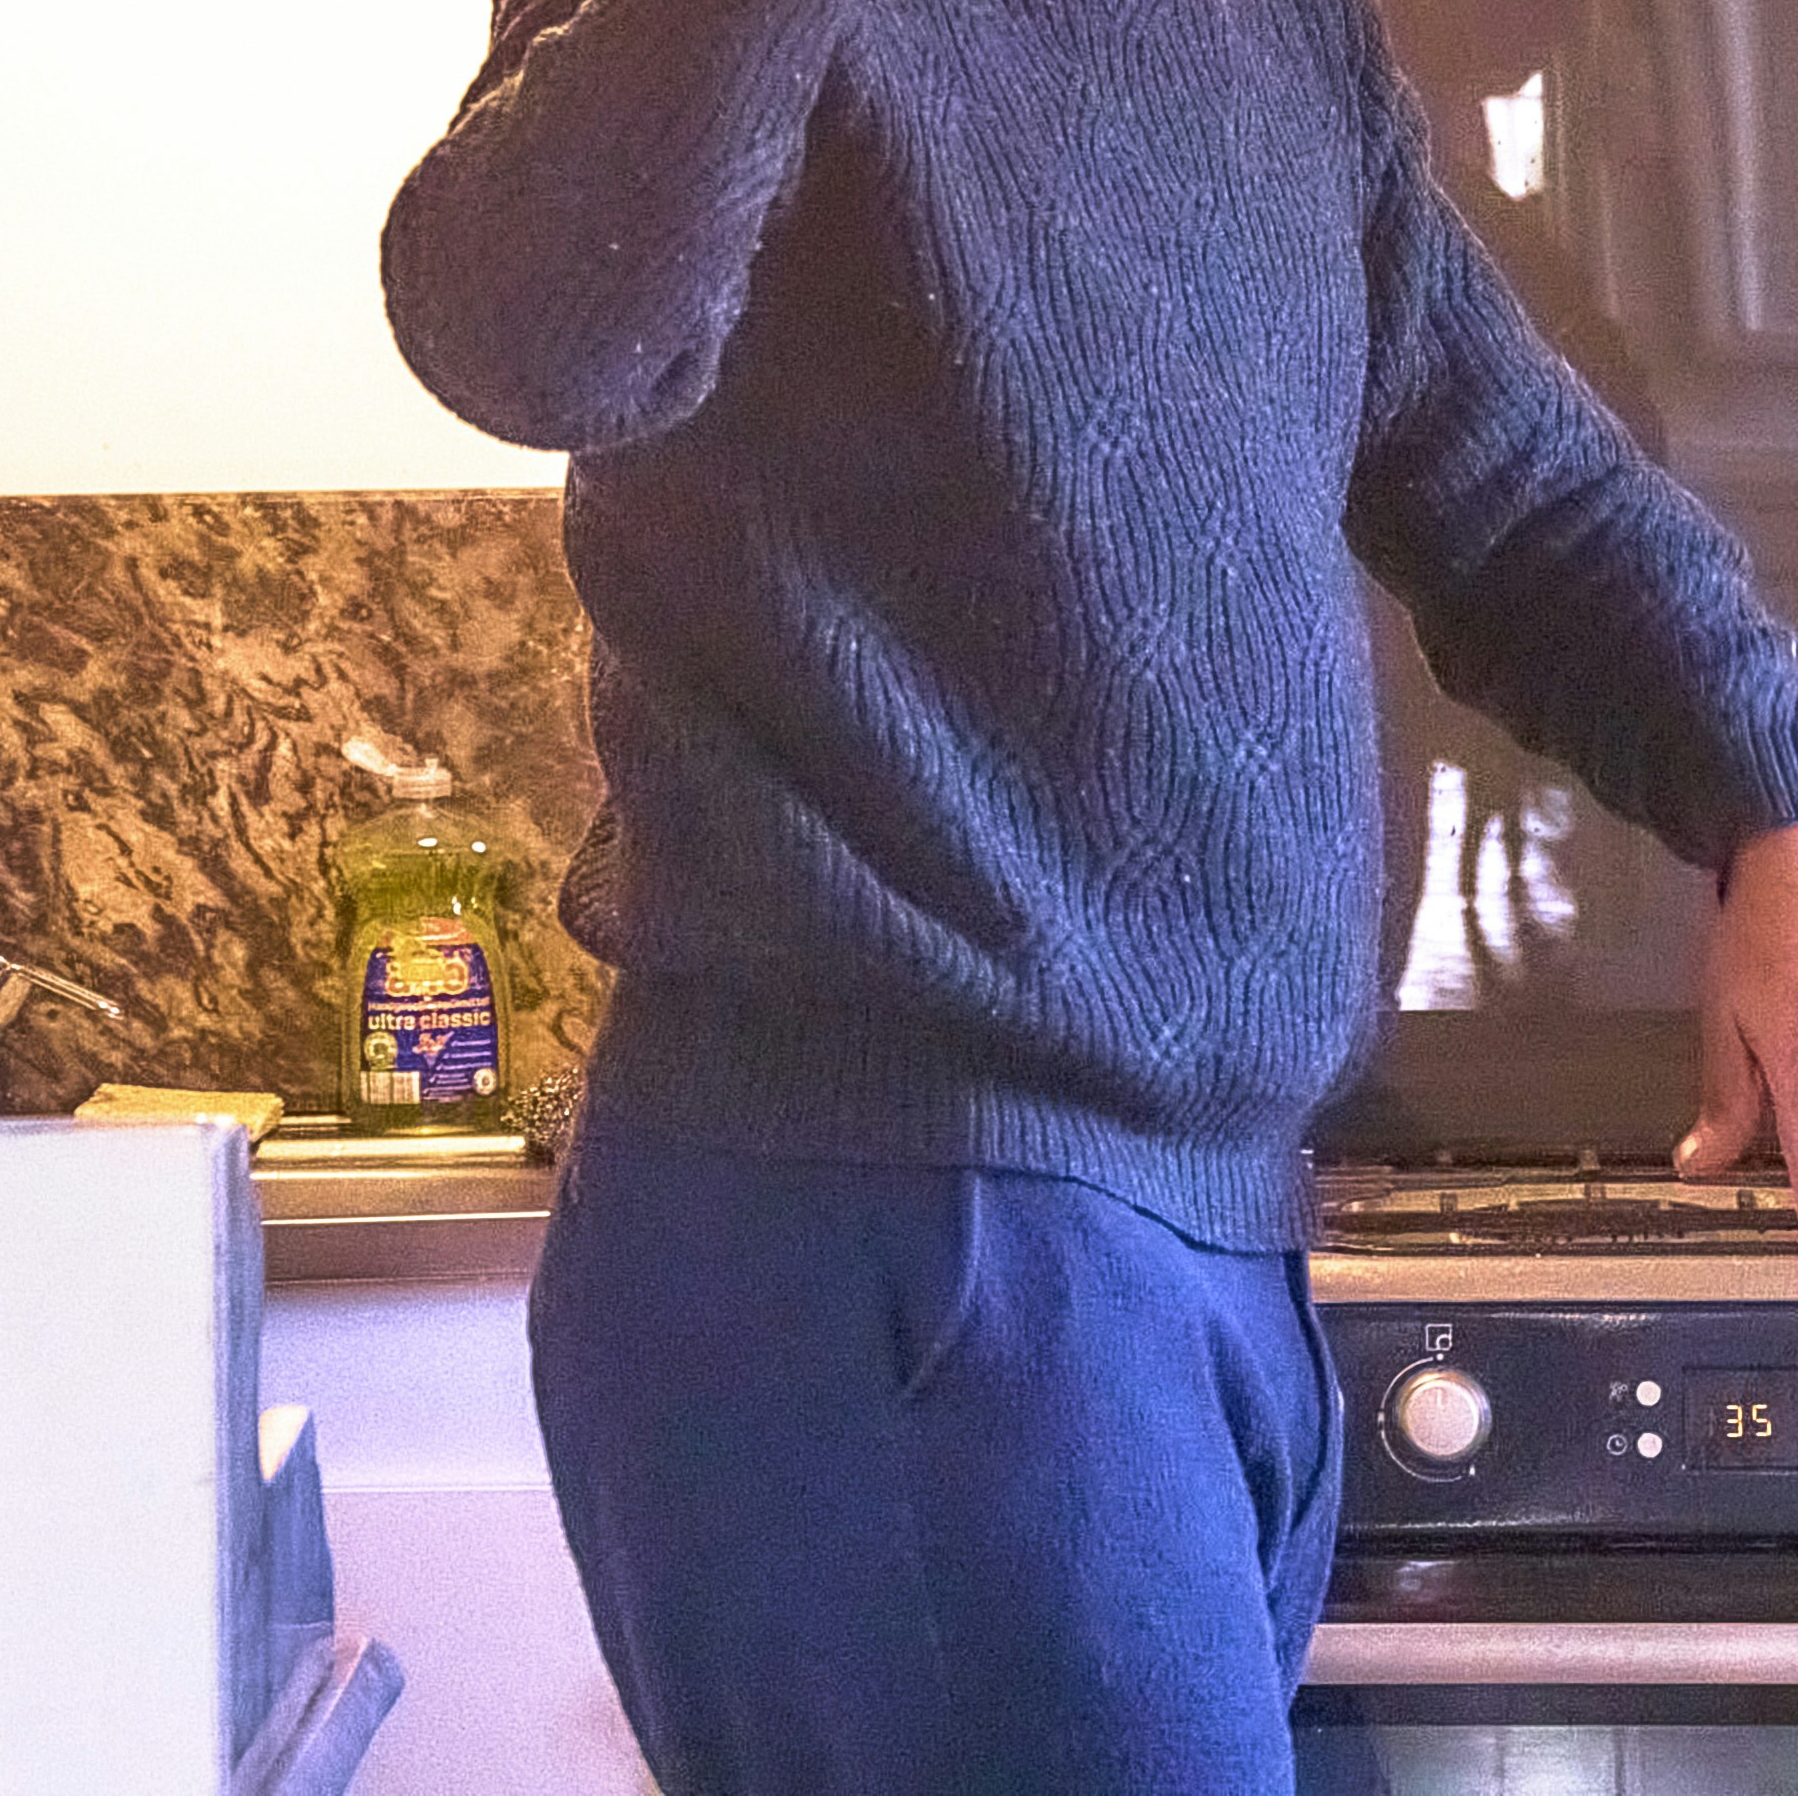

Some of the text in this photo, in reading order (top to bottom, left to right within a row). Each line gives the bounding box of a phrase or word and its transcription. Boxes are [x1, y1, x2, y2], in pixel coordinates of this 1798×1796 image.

[368, 1011, 491, 1030] ultra classic
[1726, 1404, 1772, 1437] 35
